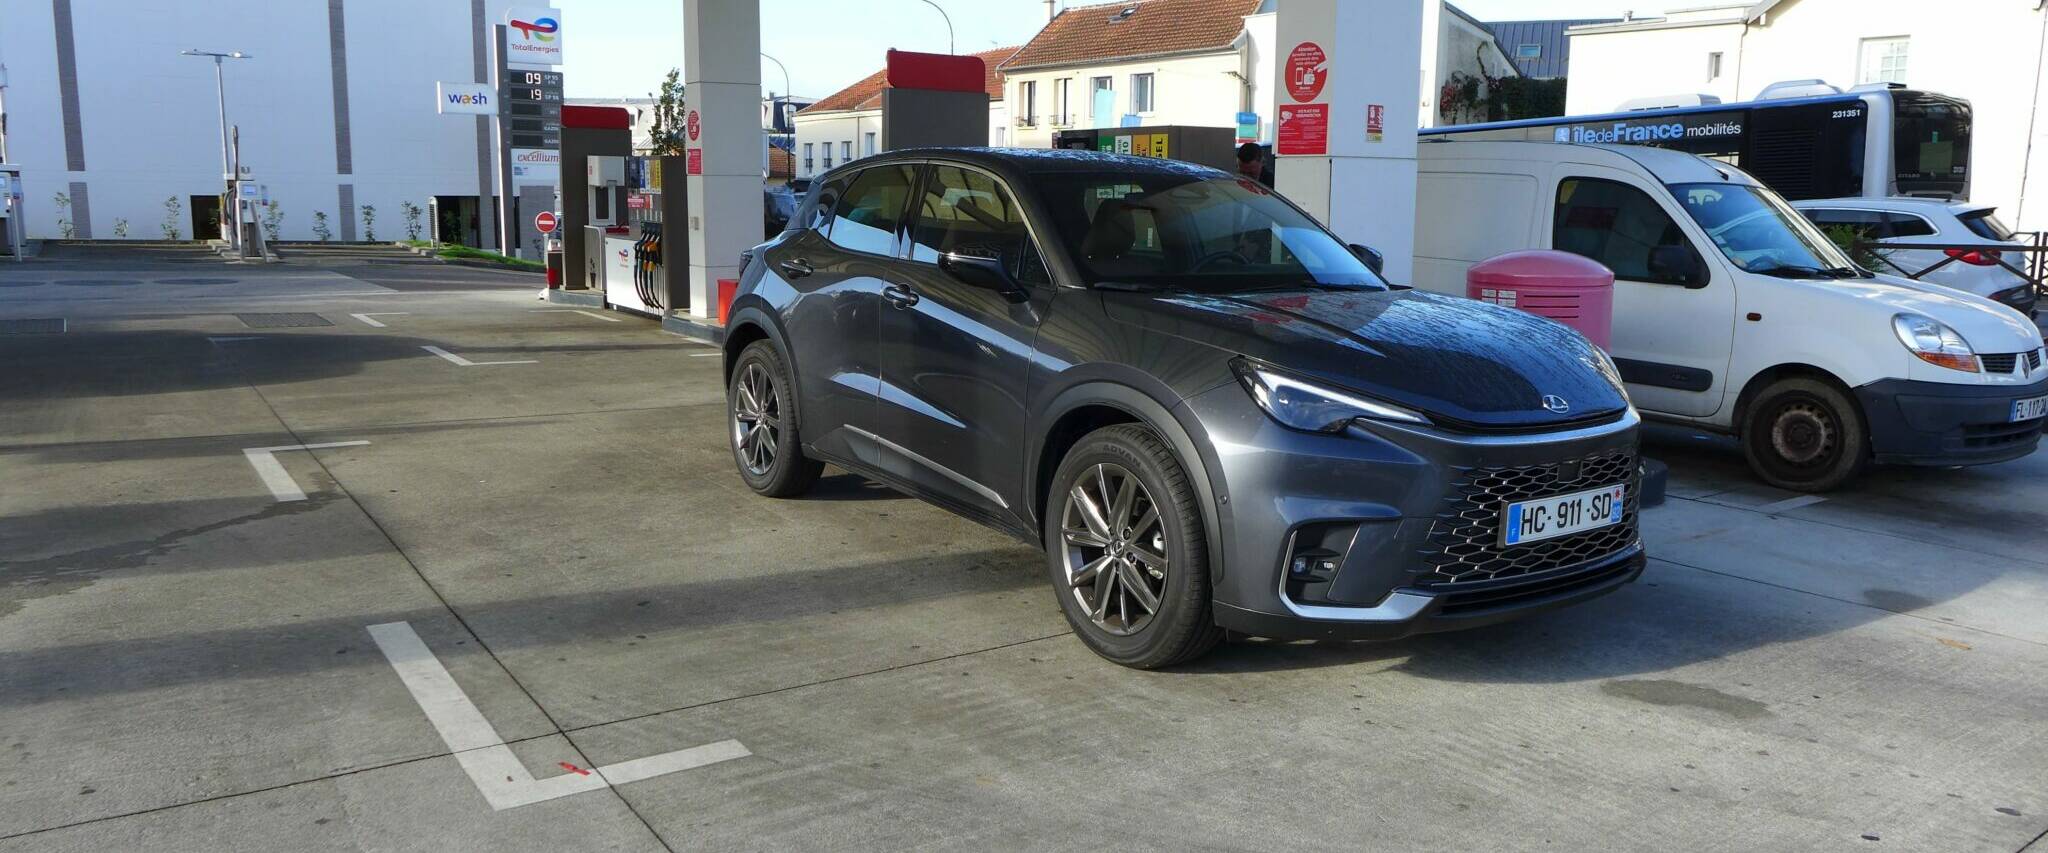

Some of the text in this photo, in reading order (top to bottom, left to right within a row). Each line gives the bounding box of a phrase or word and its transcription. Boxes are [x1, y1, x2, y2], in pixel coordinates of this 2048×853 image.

[512, 44, 560, 54] TotalEnergies
[525, 72, 541, 85] 09
[448, 92, 487, 105] wash
[530, 88, 542, 101] 19
[1832, 109, 1861, 119] 231351
[1687, 120, 1742, 137] mobilités
